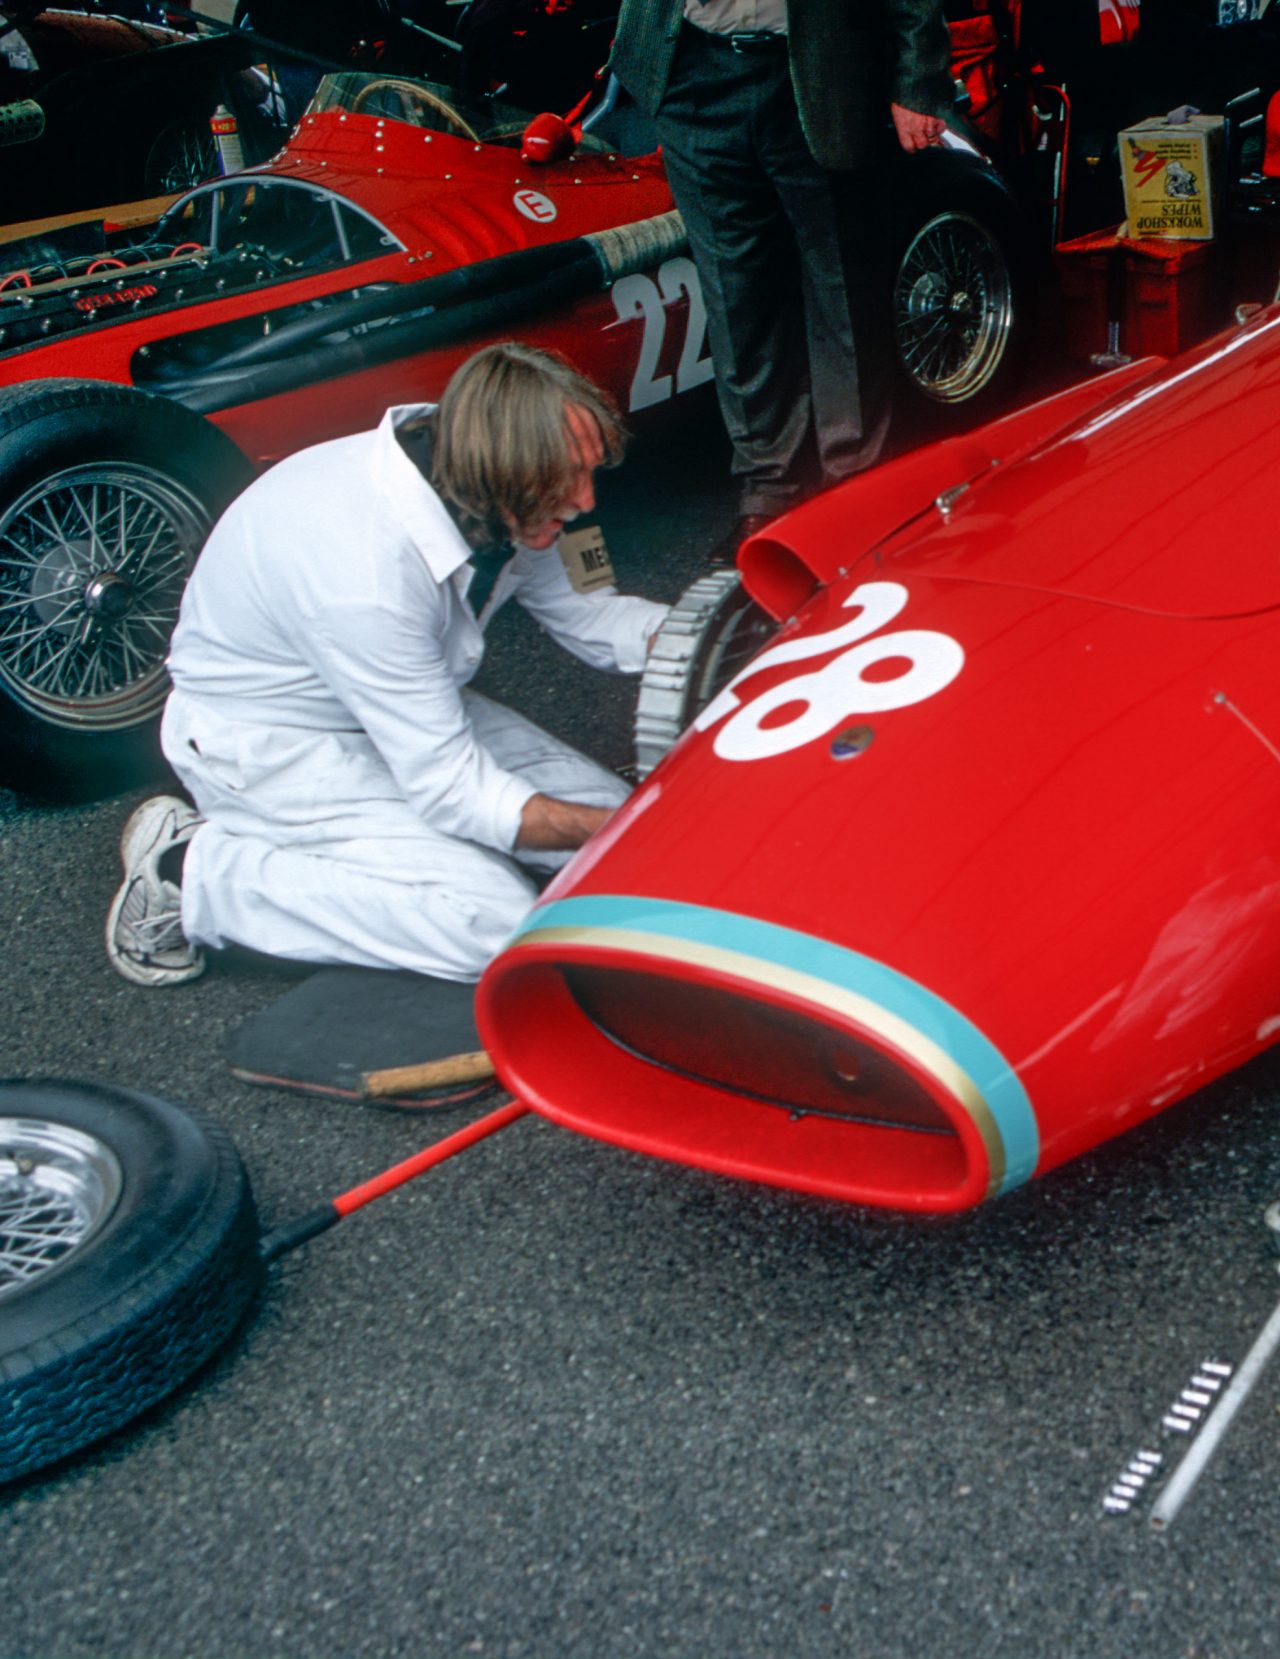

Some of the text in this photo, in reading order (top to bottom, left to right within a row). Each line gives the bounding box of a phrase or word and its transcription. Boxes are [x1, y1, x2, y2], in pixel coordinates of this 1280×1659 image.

[518, 192, 553, 220] E
[1162, 203, 1202, 217] WIPES
[1137, 217, 1203, 229] WORKSHOP
[611, 256, 716, 413] 22
[694, 581, 965, 761] 28
